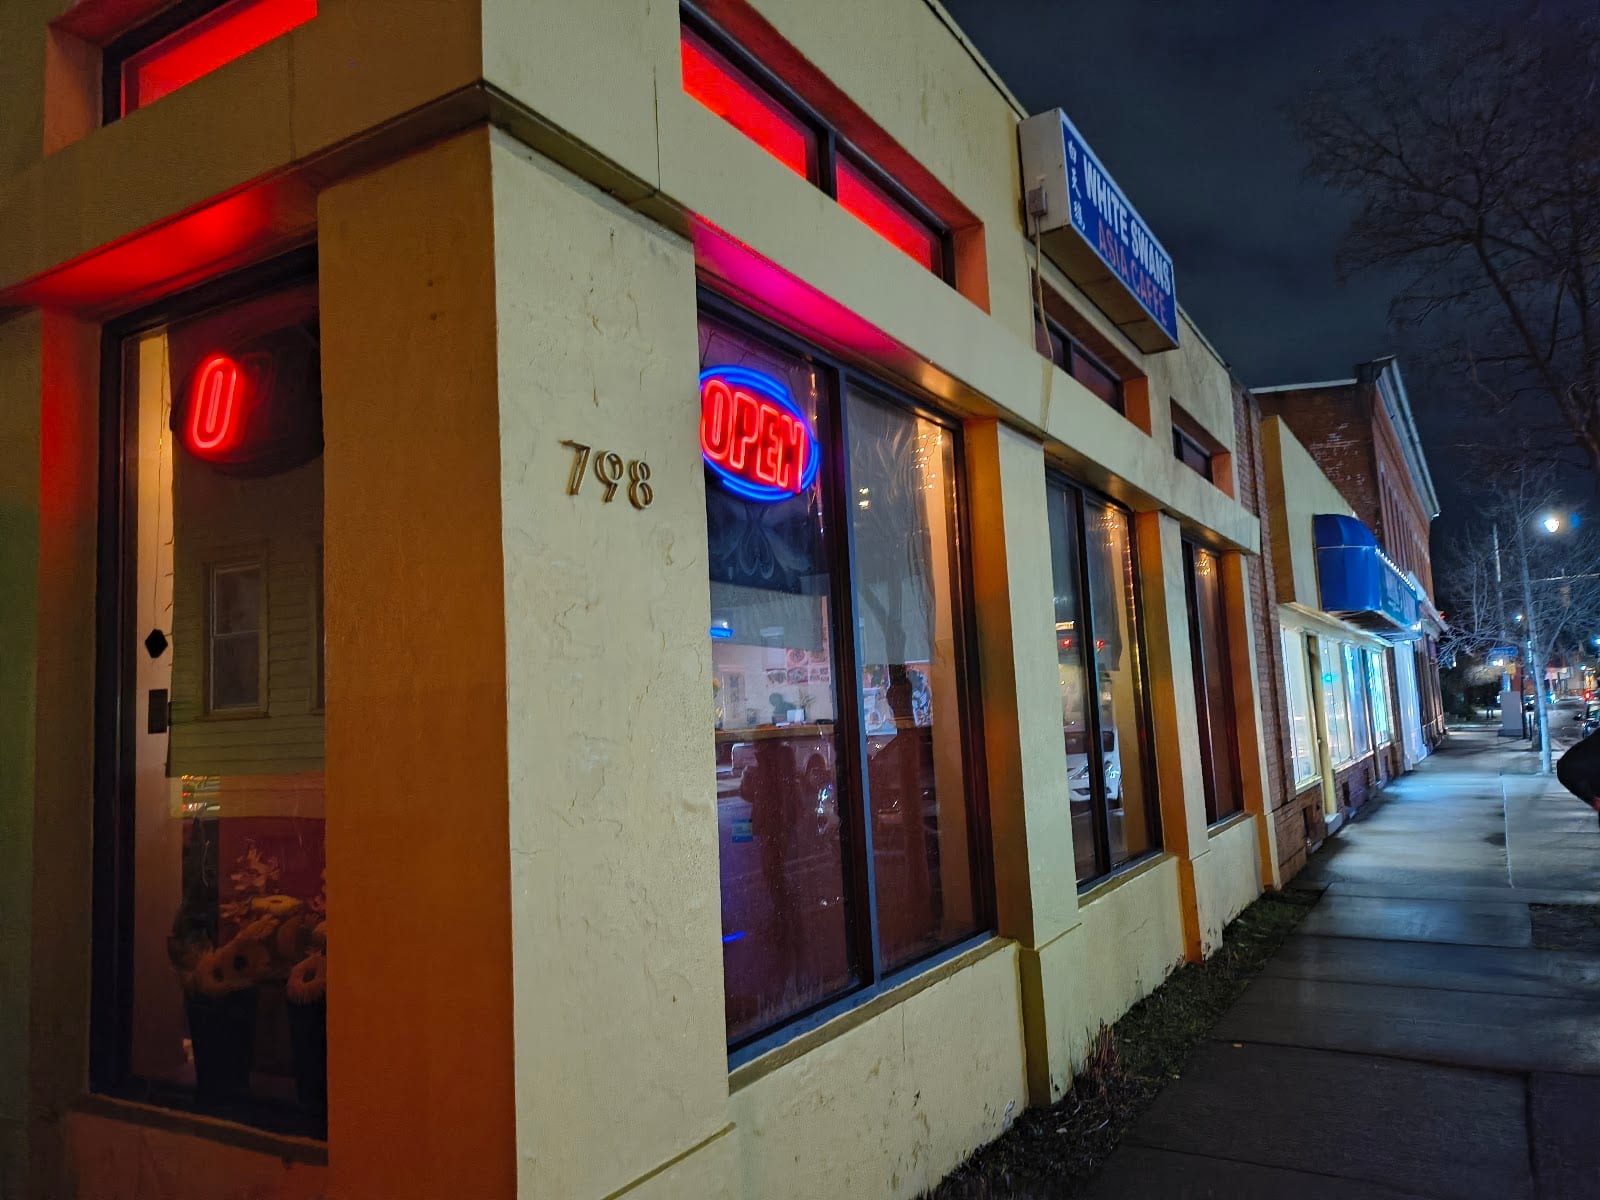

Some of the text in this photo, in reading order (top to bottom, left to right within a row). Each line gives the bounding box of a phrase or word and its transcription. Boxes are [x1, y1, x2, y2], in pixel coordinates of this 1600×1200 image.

[1083, 158, 1171, 296] WHITE SWANS
[1098, 219, 1168, 327] ASIA CAFFE
[558, 439, 655, 510] 798
[700, 379, 805, 495] OPEN
